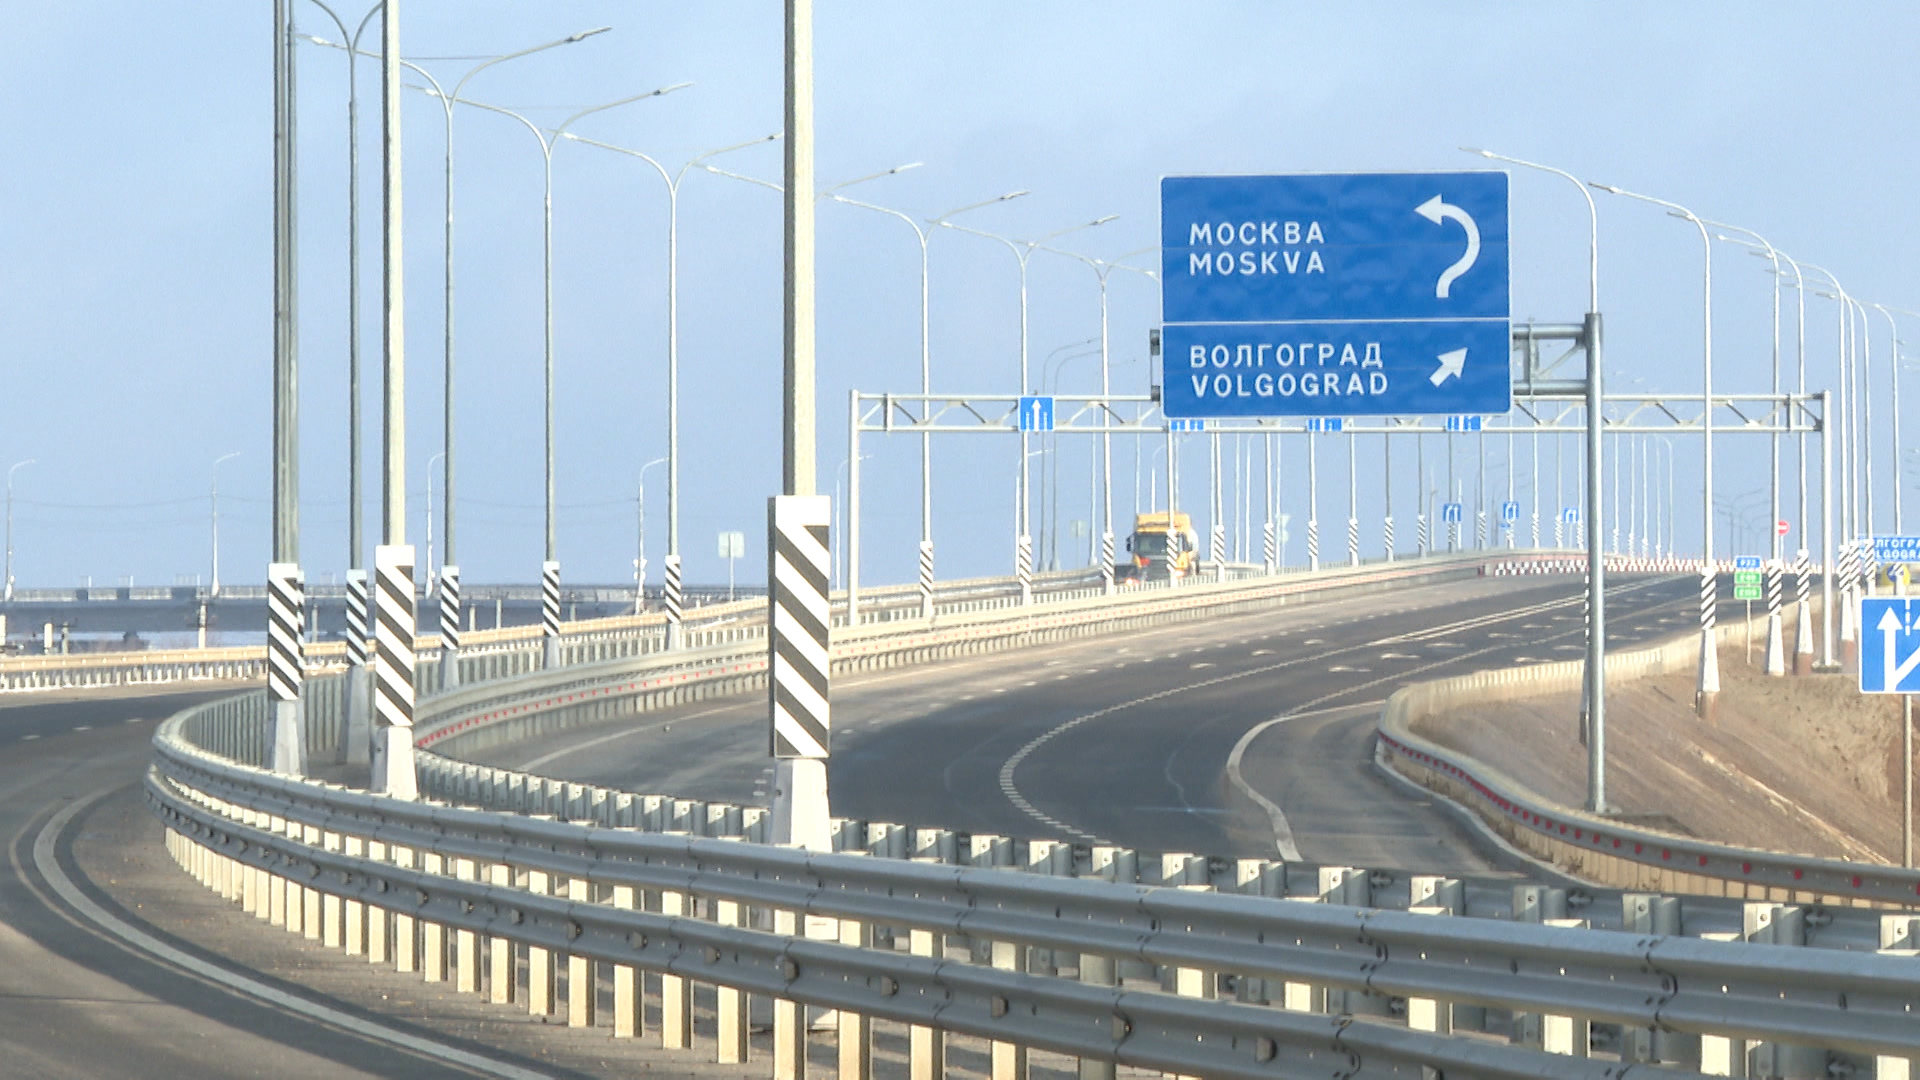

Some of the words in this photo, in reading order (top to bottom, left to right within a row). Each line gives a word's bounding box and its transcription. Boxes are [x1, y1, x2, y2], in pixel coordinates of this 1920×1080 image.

[1189, 221, 1325, 246] МОСКВА
[1189, 251, 1325, 276] MOSKVA
[1190, 342, 1383, 369] ВОЛГОГРАД
[1191, 373, 1388, 398] VOLGOGRAD
